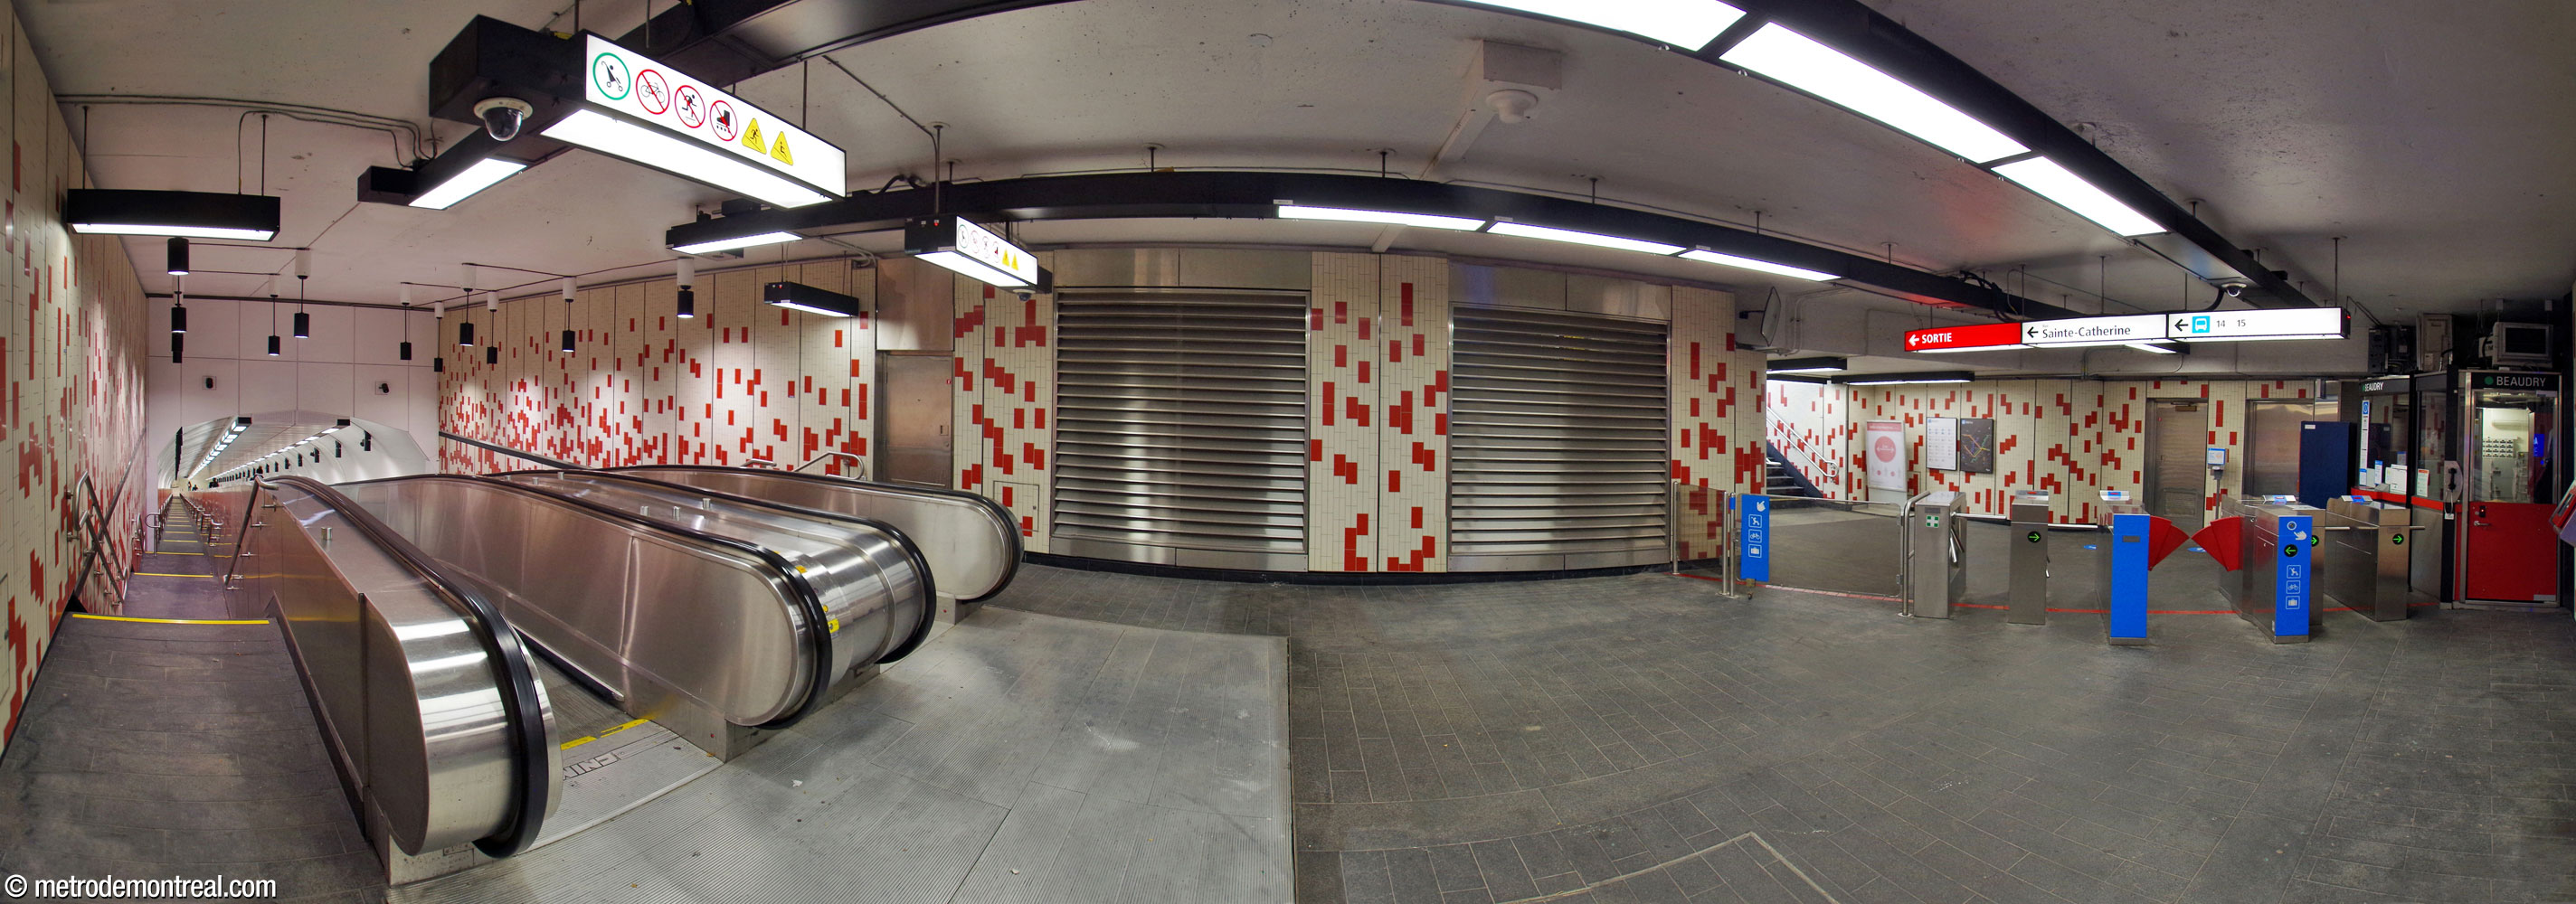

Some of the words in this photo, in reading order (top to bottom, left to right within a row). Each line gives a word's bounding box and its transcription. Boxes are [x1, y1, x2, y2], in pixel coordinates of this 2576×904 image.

[2237, 319, 2246, 327] 15
[2042, 325, 2131, 338] Sainte-Catherine
[1922, 333, 1952, 344] SORTIE
[2496, 376, 2546, 387] BEAUDRY
